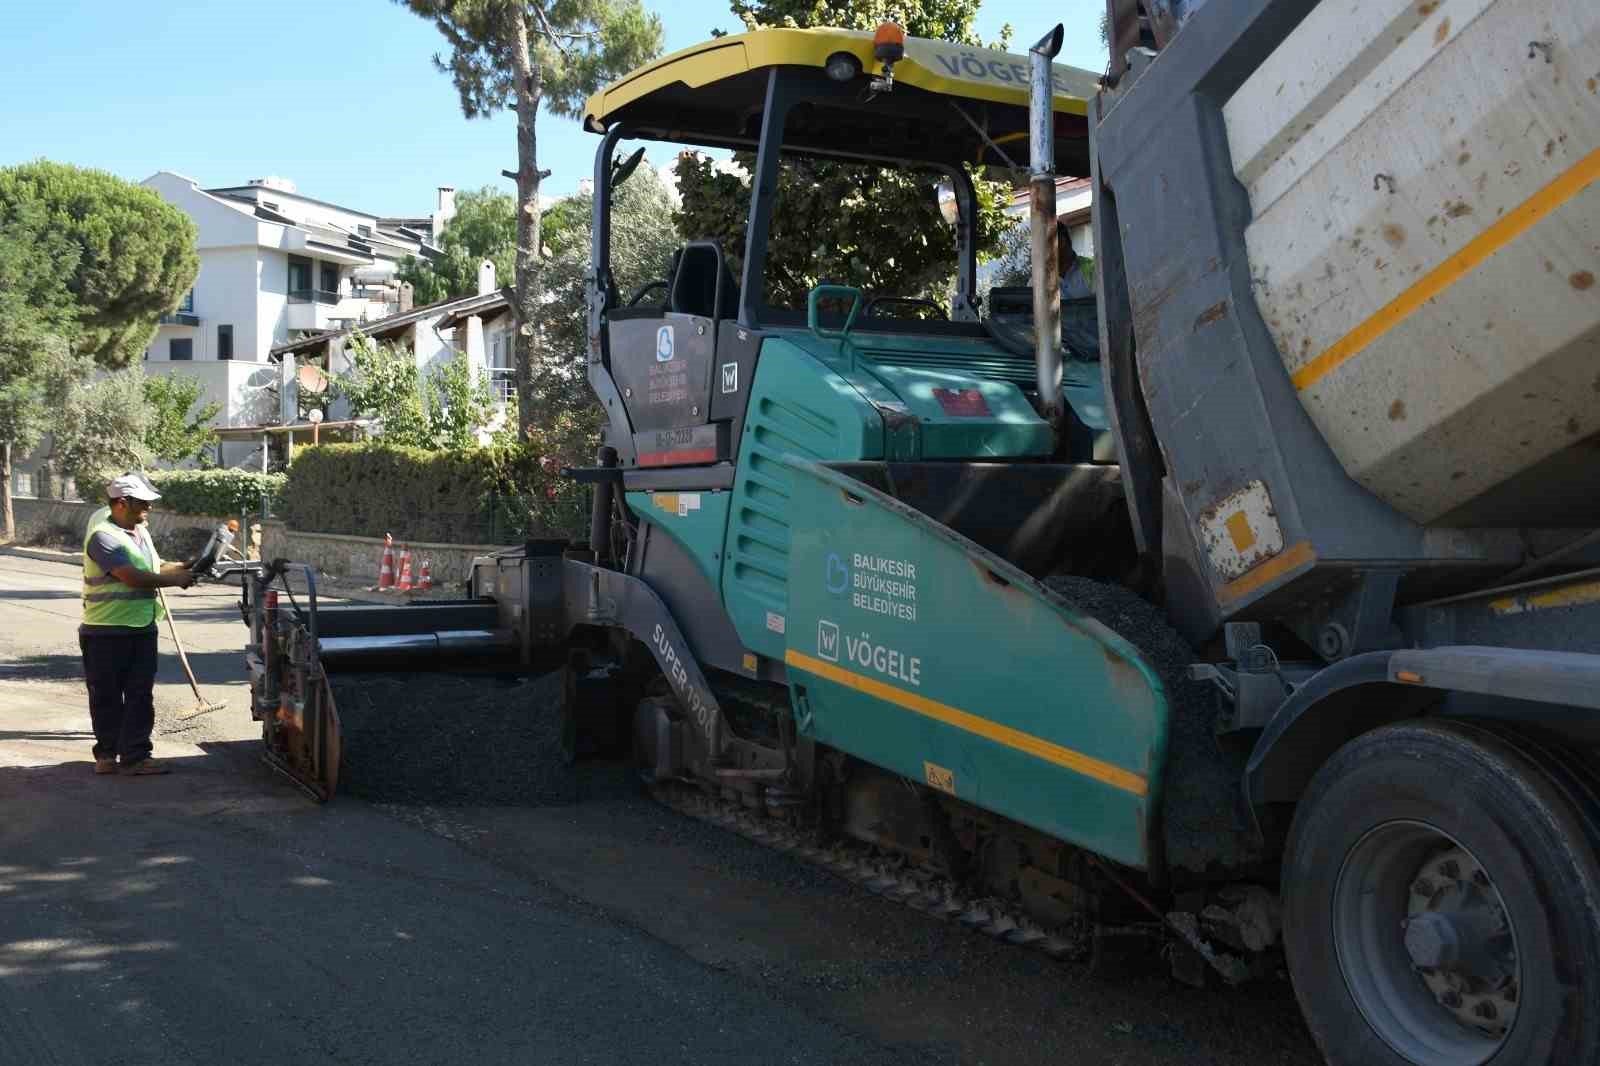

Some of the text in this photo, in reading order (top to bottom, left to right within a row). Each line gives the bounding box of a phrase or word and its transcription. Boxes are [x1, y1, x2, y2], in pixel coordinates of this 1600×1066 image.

[936, 51, 1070, 92] VÖGEE
[853, 552, 917, 580] BALIKESİR
[853, 571, 917, 601] BÜYÜKŞEHİR
[853, 592, 917, 622] BELEDİYESİ
[653, 623, 688, 692] SUPER
[845, 631, 921, 687] VÖGELE
